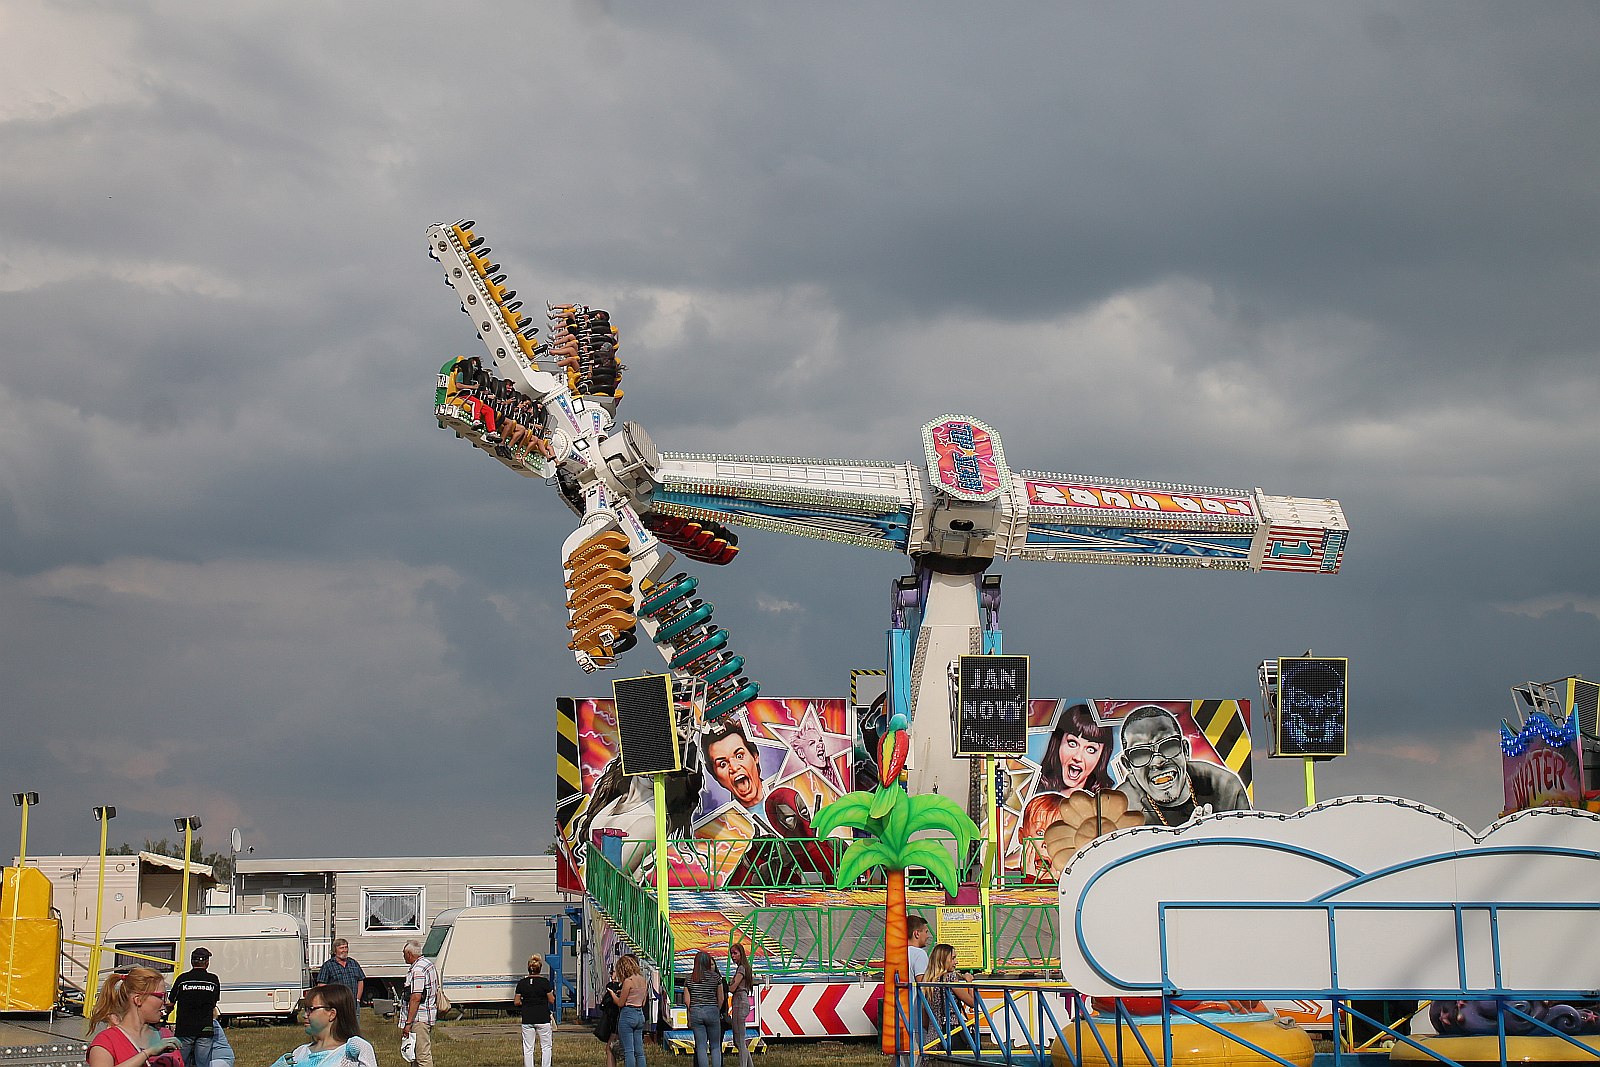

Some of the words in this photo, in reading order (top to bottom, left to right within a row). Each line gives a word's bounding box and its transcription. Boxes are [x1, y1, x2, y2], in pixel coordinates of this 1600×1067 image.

[588, 490, 597, 498] 4
[616, 510, 625, 523] 5
[1270, 540, 1314, 558] 1
[1320, 533, 1343, 571] NUMBER
[970, 668, 1016, 690] JAN
[963, 694, 1025, 720] NOVÝ
[1512, 749, 1566, 809] WATER
[182, 984, 215, 992] Kawasaki
